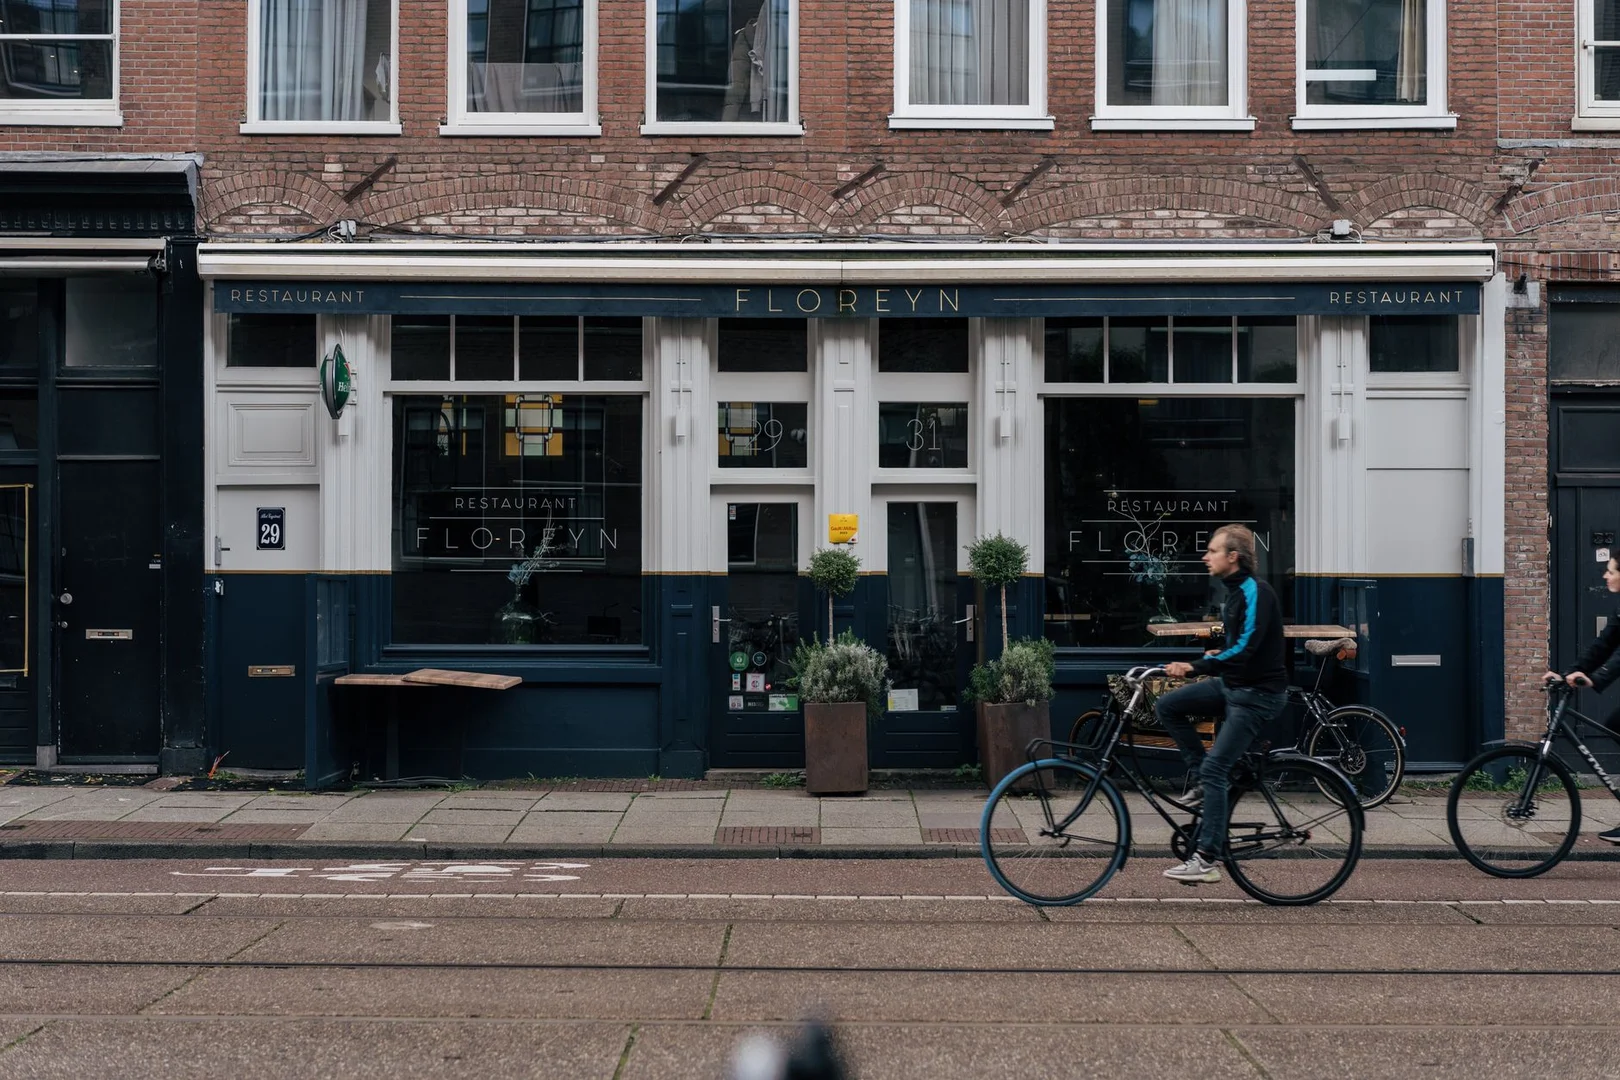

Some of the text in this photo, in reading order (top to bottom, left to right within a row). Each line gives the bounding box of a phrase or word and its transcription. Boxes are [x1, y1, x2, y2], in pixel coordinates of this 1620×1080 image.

[231, 289, 365, 303] RESTAURANT
[736, 289, 958, 313] FLOREYN
[1330, 291, 1463, 304] RESTAURANT
[744, 419, 784, 451] 29
[906, 419, 941, 450] 31
[455, 497, 576, 509] RESTAURANT
[1107, 500, 1229, 512] RESTAURANT
[261, 523, 280, 544] 29
[416, 527, 617, 549] FLOREYN
[1069, 530, 1270, 552] FLOREN
